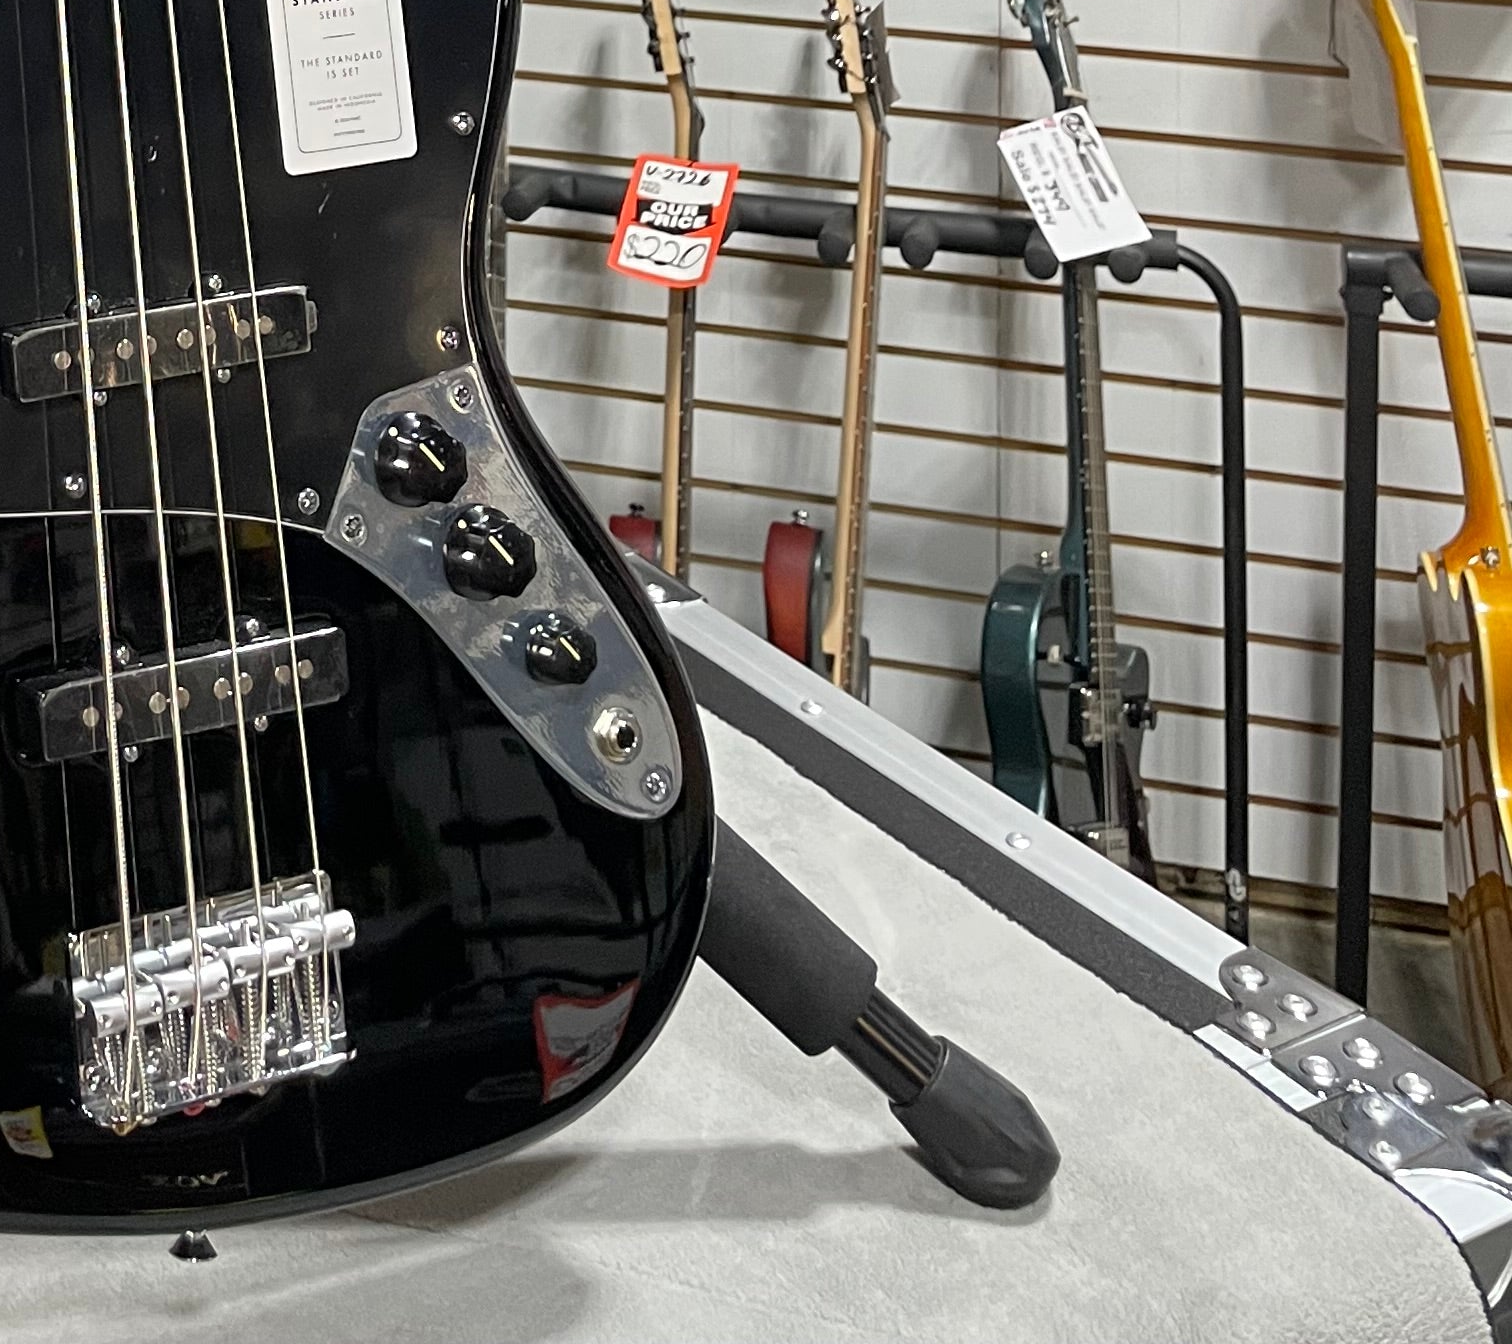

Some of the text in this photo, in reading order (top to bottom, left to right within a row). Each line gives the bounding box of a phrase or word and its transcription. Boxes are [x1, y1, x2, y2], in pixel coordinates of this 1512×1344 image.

[318, 7, 356, 20] SERIES
[299, 48, 384, 69] THE STANDARD
[325, 65, 361, 80] IS SET
[1010, 149, 1032, 182] Sale
[649, 201, 700, 217] OUR
[639, 210, 709, 230] PRICE
[623, 232, 708, 270] $220
